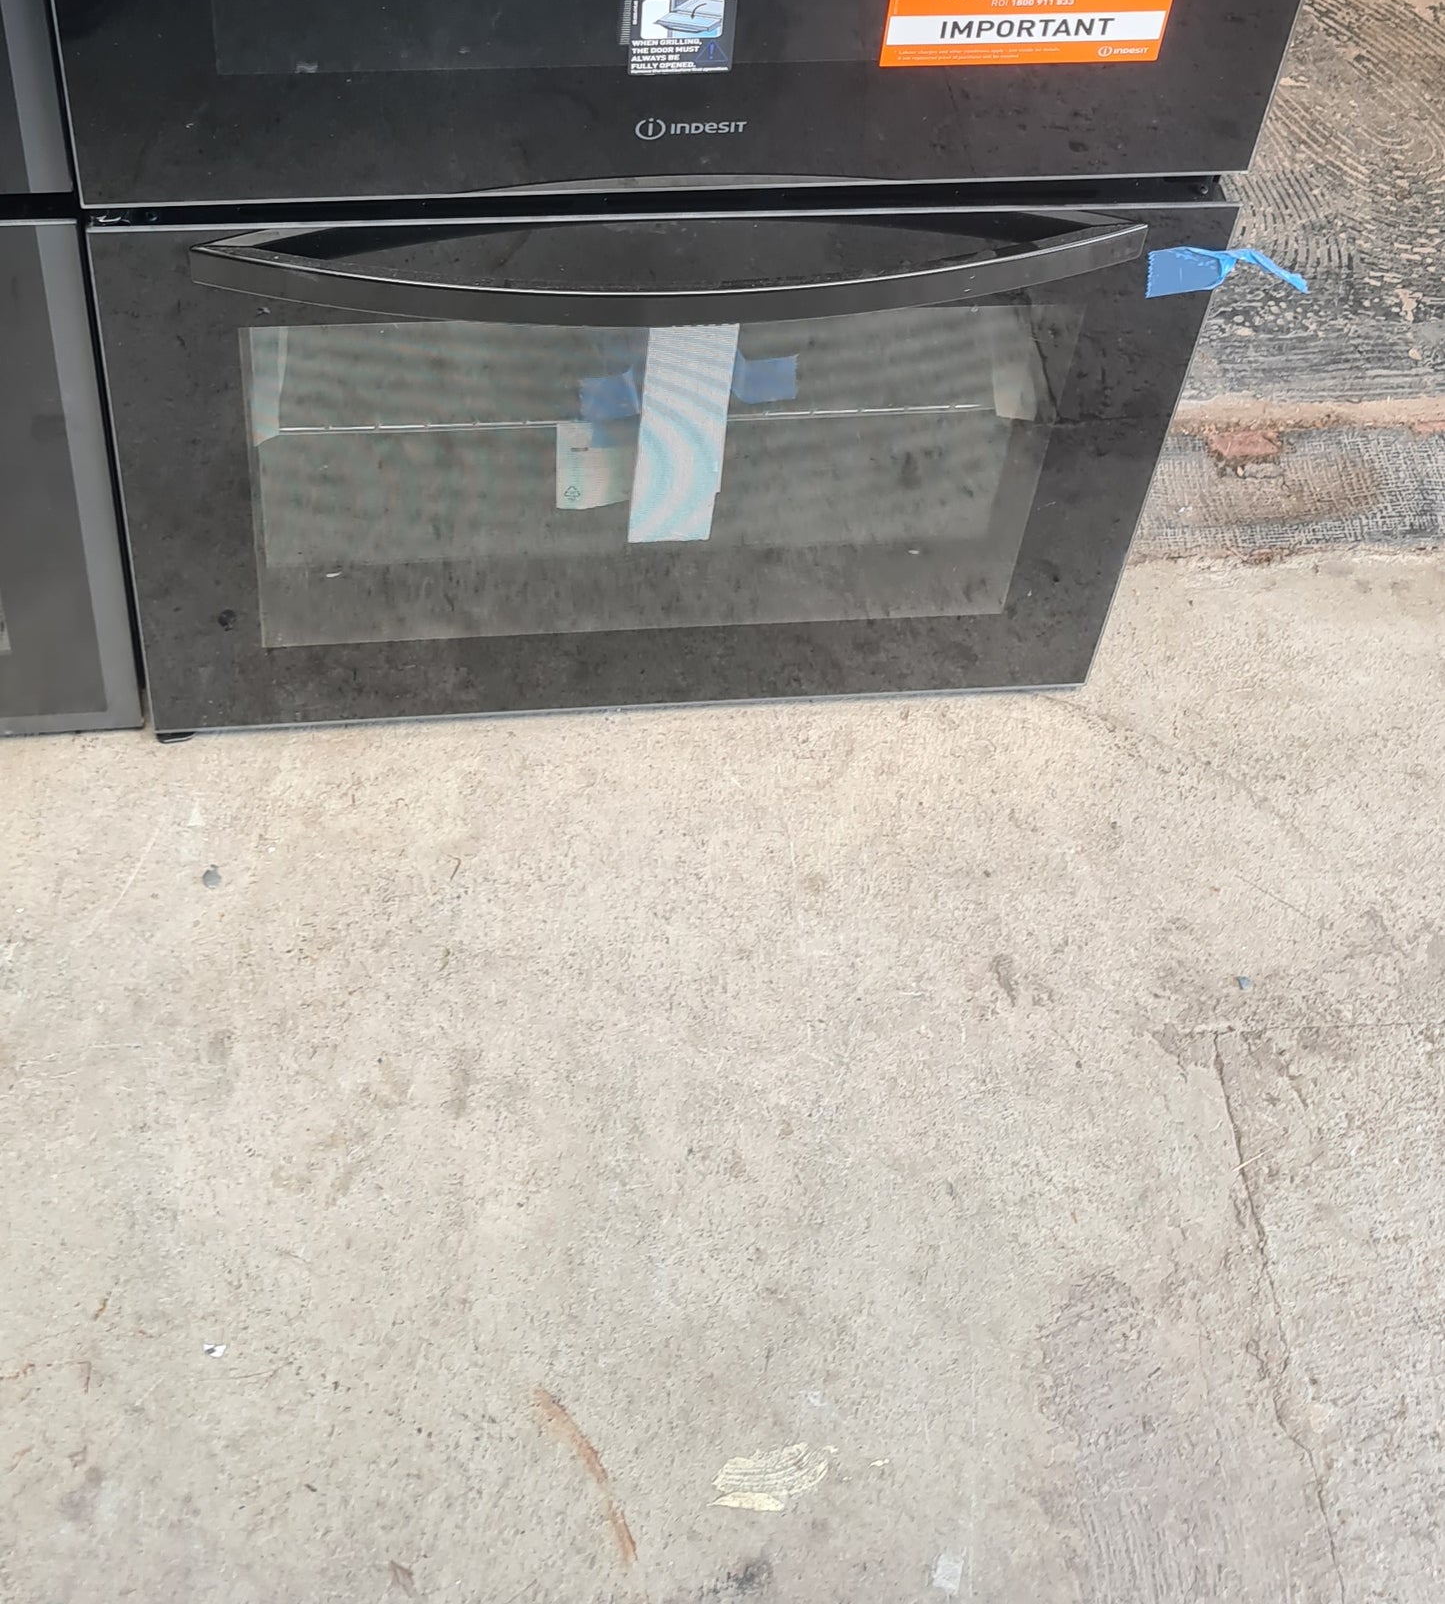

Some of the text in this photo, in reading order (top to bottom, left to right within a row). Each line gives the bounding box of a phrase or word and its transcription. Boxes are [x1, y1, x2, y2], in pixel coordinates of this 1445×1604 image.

[991, 0, 1008, 7] ROI
[1011, 0, 1034, 7] 1800
[940, 18, 1115, 39] IMPORTANT
[631, 62, 659, 70] FULLY
